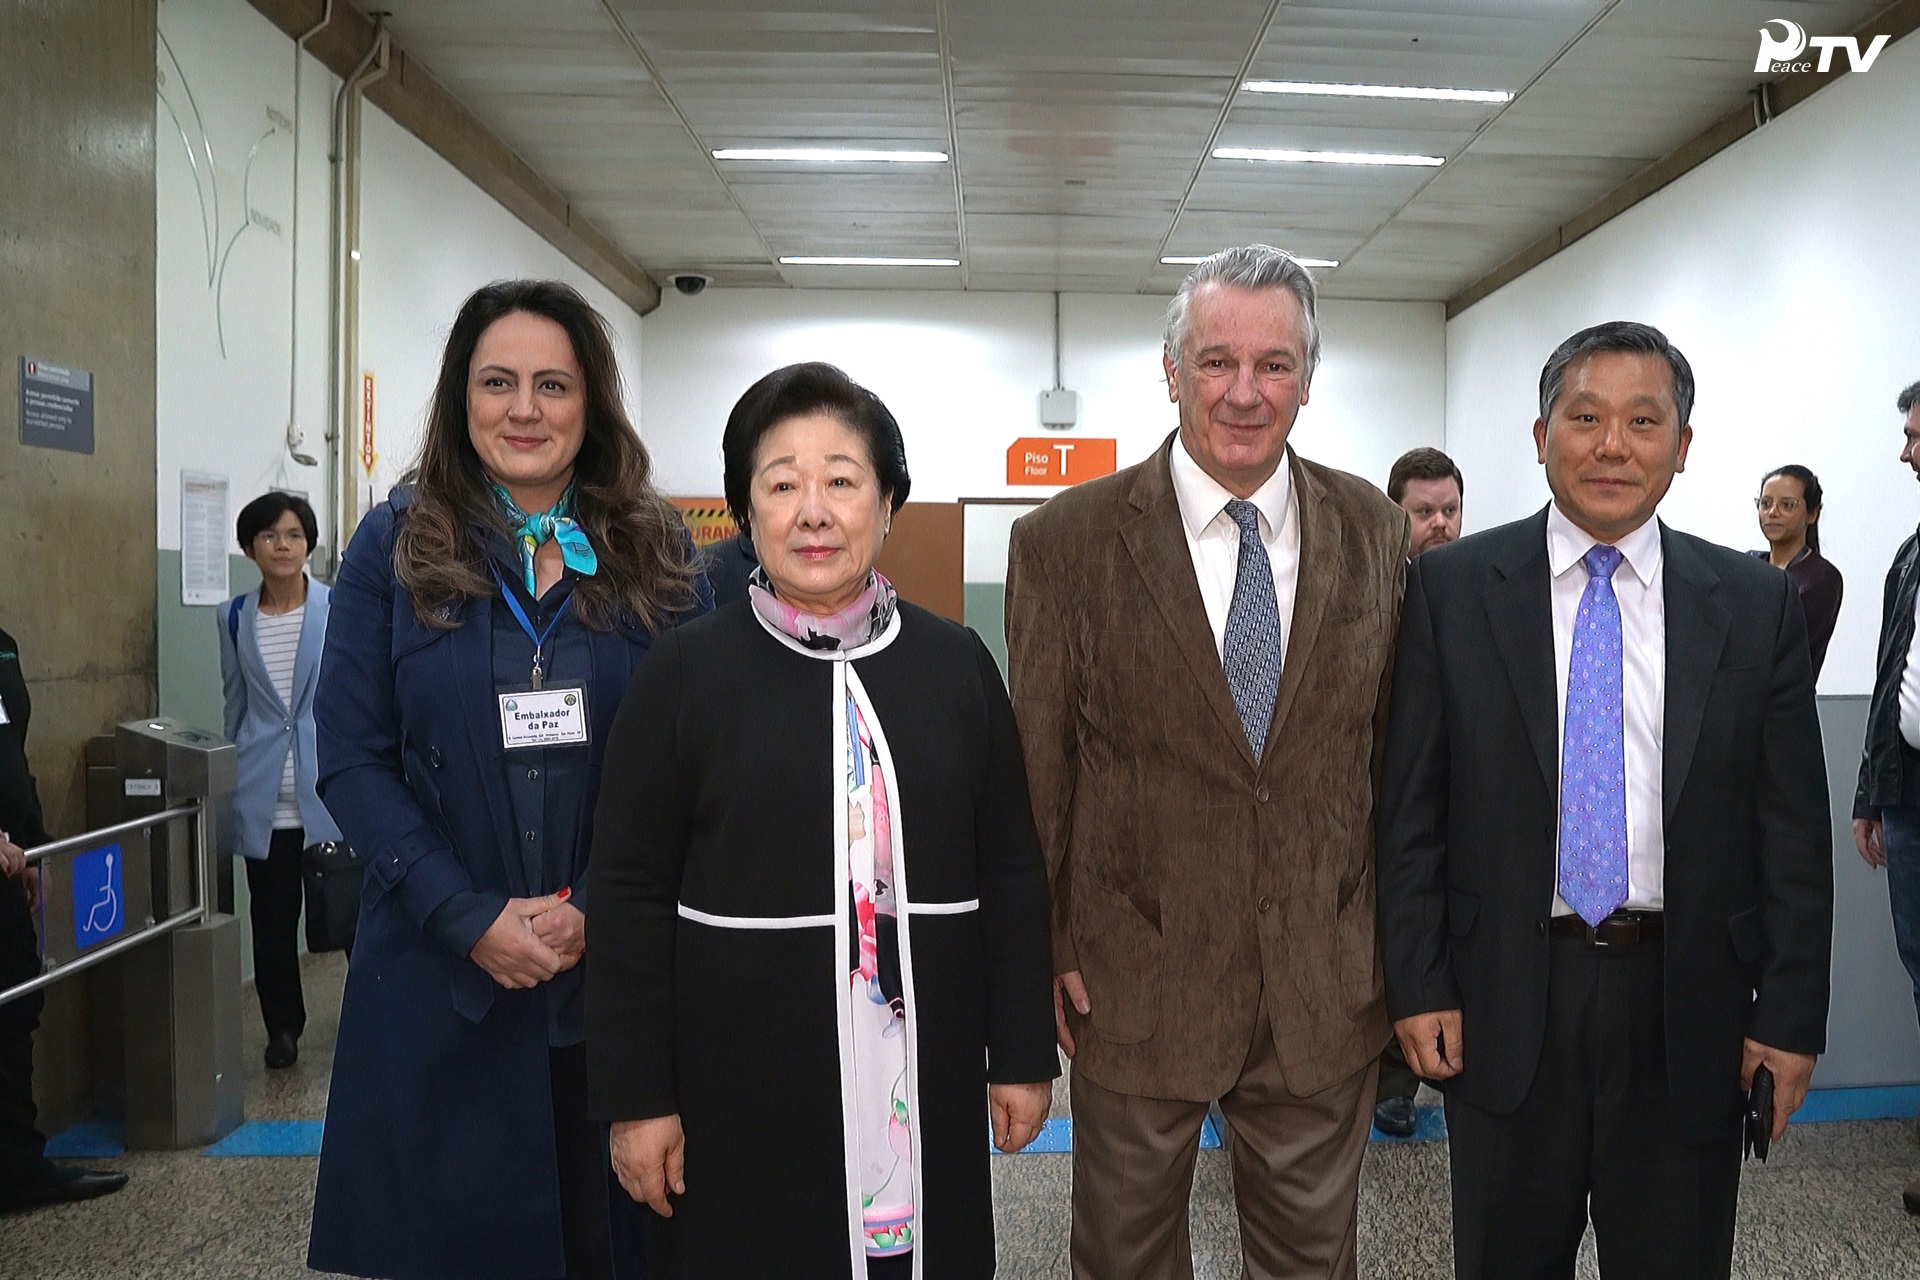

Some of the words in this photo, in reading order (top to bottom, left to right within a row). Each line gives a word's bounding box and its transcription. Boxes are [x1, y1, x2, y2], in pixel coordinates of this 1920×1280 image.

[1024, 452, 1049, 464] Piso
[1053, 444, 1075, 476] T
[1024, 466, 1048, 476] Floor
[514, 709, 571, 720] Embaixador
[528, 722, 540, 730] da
[542, 721, 559, 729] Paz
